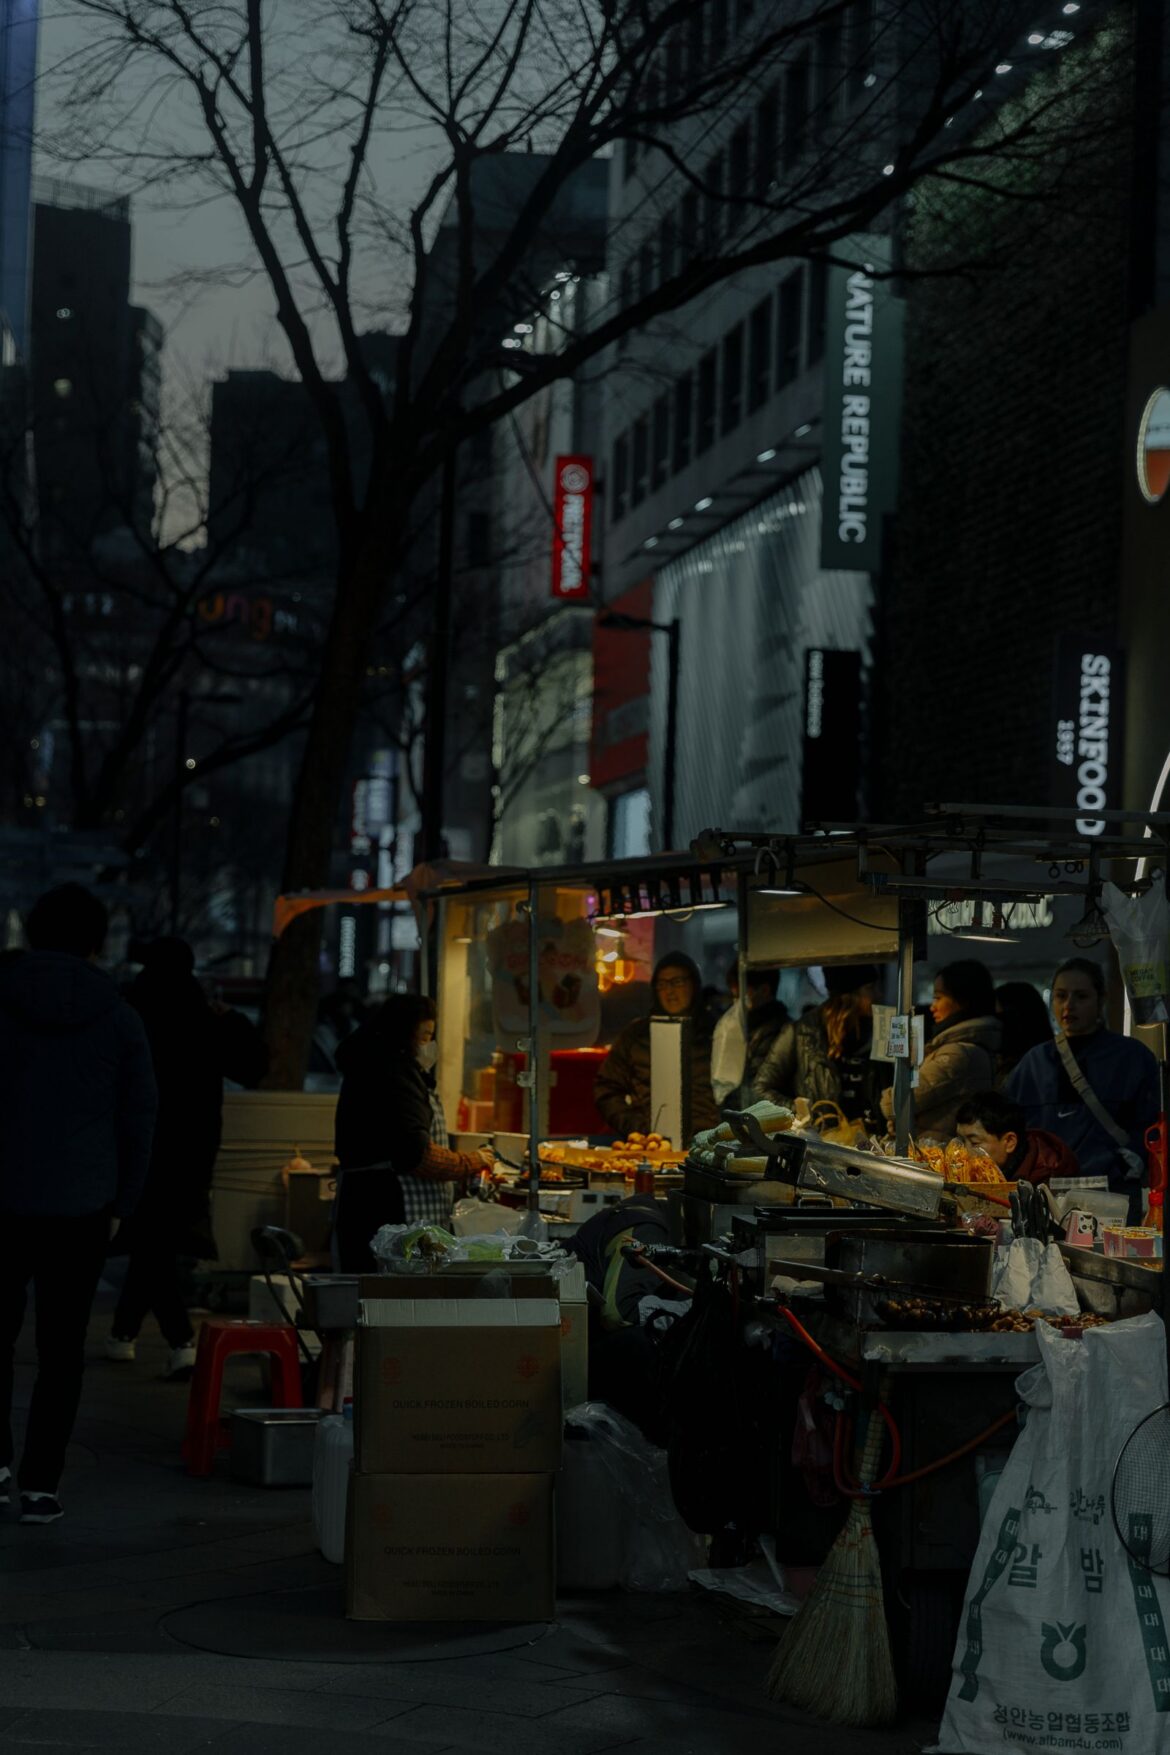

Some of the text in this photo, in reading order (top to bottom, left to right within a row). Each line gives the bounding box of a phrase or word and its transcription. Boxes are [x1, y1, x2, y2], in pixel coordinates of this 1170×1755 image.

[838, 263, 875, 545] NATURE REPUBLIC
[1075, 653, 1112, 836] SKINFOOD
[392, 1399, 528, 1409] QUICK FROZEN BOILED CORN
[384, 1545, 413, 1556] QUICK
[416, 1545, 454, 1556] FROZEN
[1008, 1543, 1105, 1593] 알 밤
[1138, 1584, 1152, 1599] 대
[1145, 1612, 1159, 1627] 대
[1150, 1646, 1166, 1662] 대
[993, 1703, 1131, 1734] 정안농업협동조합
